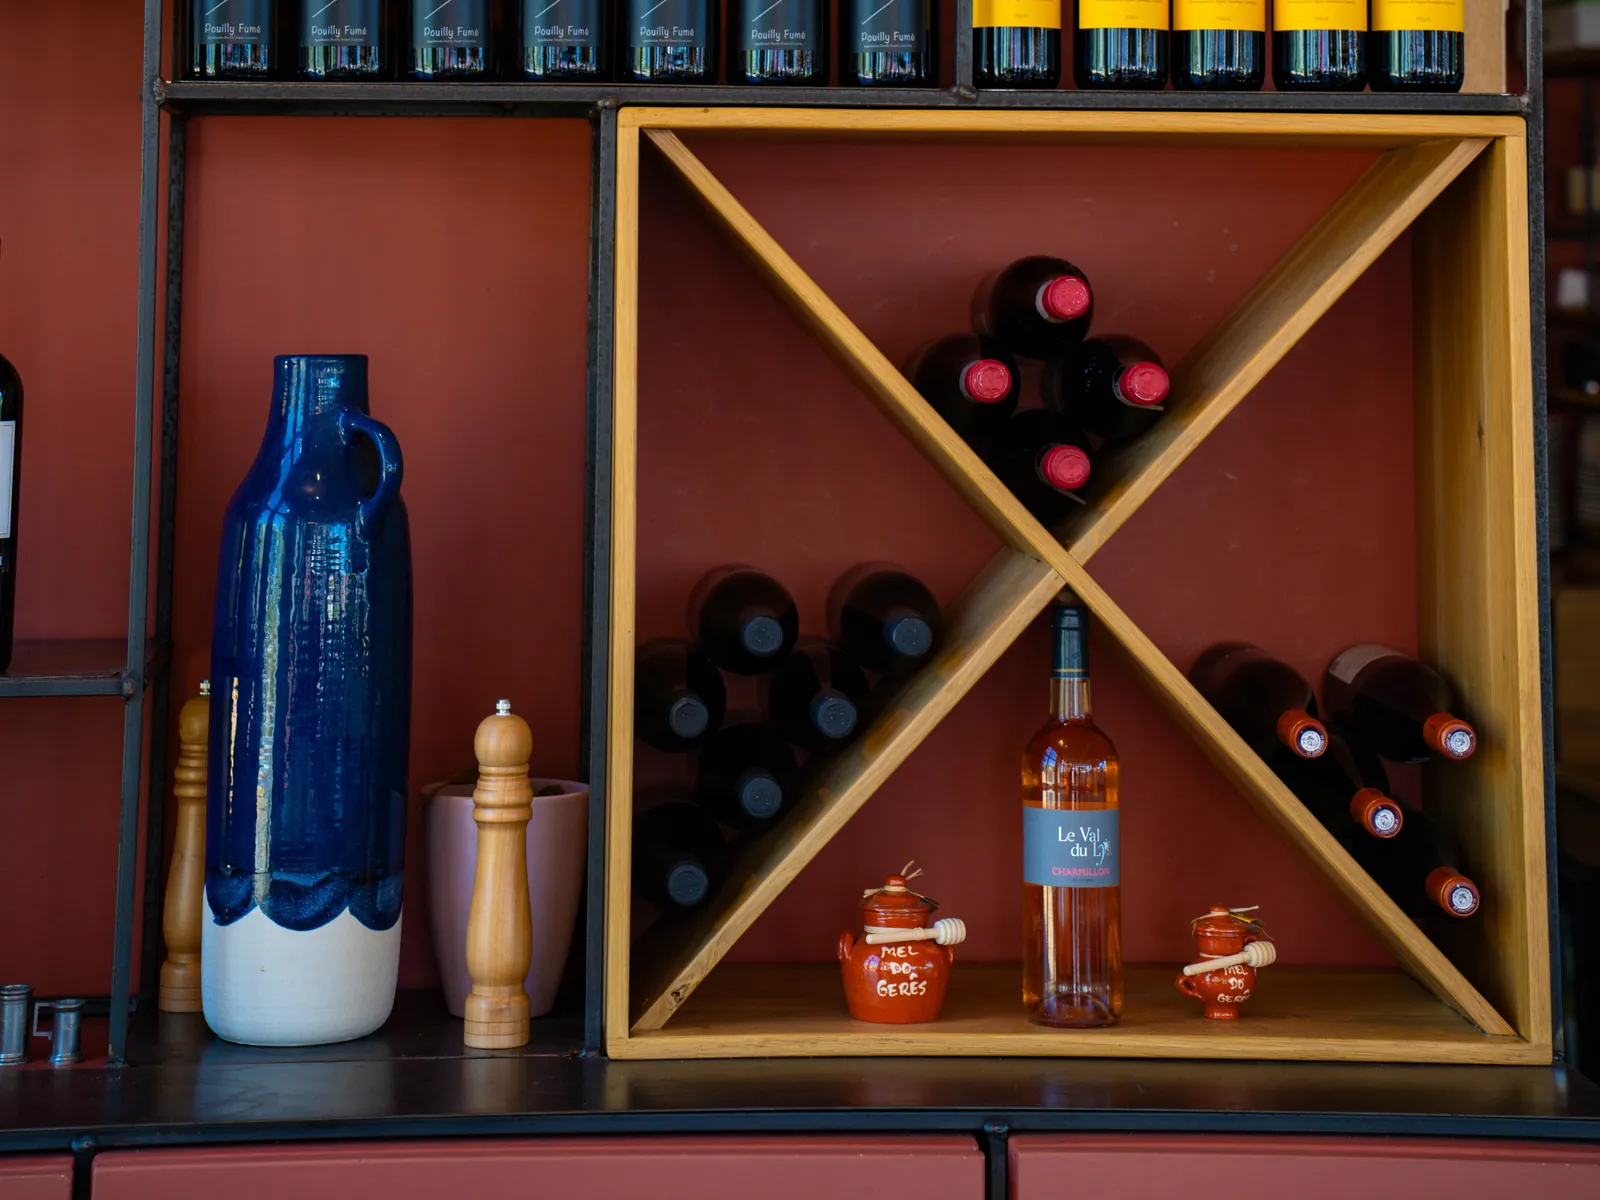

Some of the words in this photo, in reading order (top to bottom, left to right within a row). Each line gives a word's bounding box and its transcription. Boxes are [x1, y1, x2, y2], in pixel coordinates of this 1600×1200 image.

[205, 23, 235, 36] Pouilly
[311, 25, 341, 37] Pouilly
[423, 26, 454, 39] Pouilly
[534, 25, 564, 38] Pouilly
[639, 26, 669, 39] Pouilly
[751, 29, 781, 41] Pouilly
[861, 32, 890, 44] Pouilly
[1058, 826, 1076, 842] Le
[1079, 826, 1100, 842] Val
[1070, 843, 1088, 857] du
[1051, 866, 1111, 877] CHARMILLON
[881, 945, 920, 959] MEL
[889, 962, 912, 975] DO
[1224, 964, 1249, 976] MEL
[1228, 977, 1245, 990] DO
